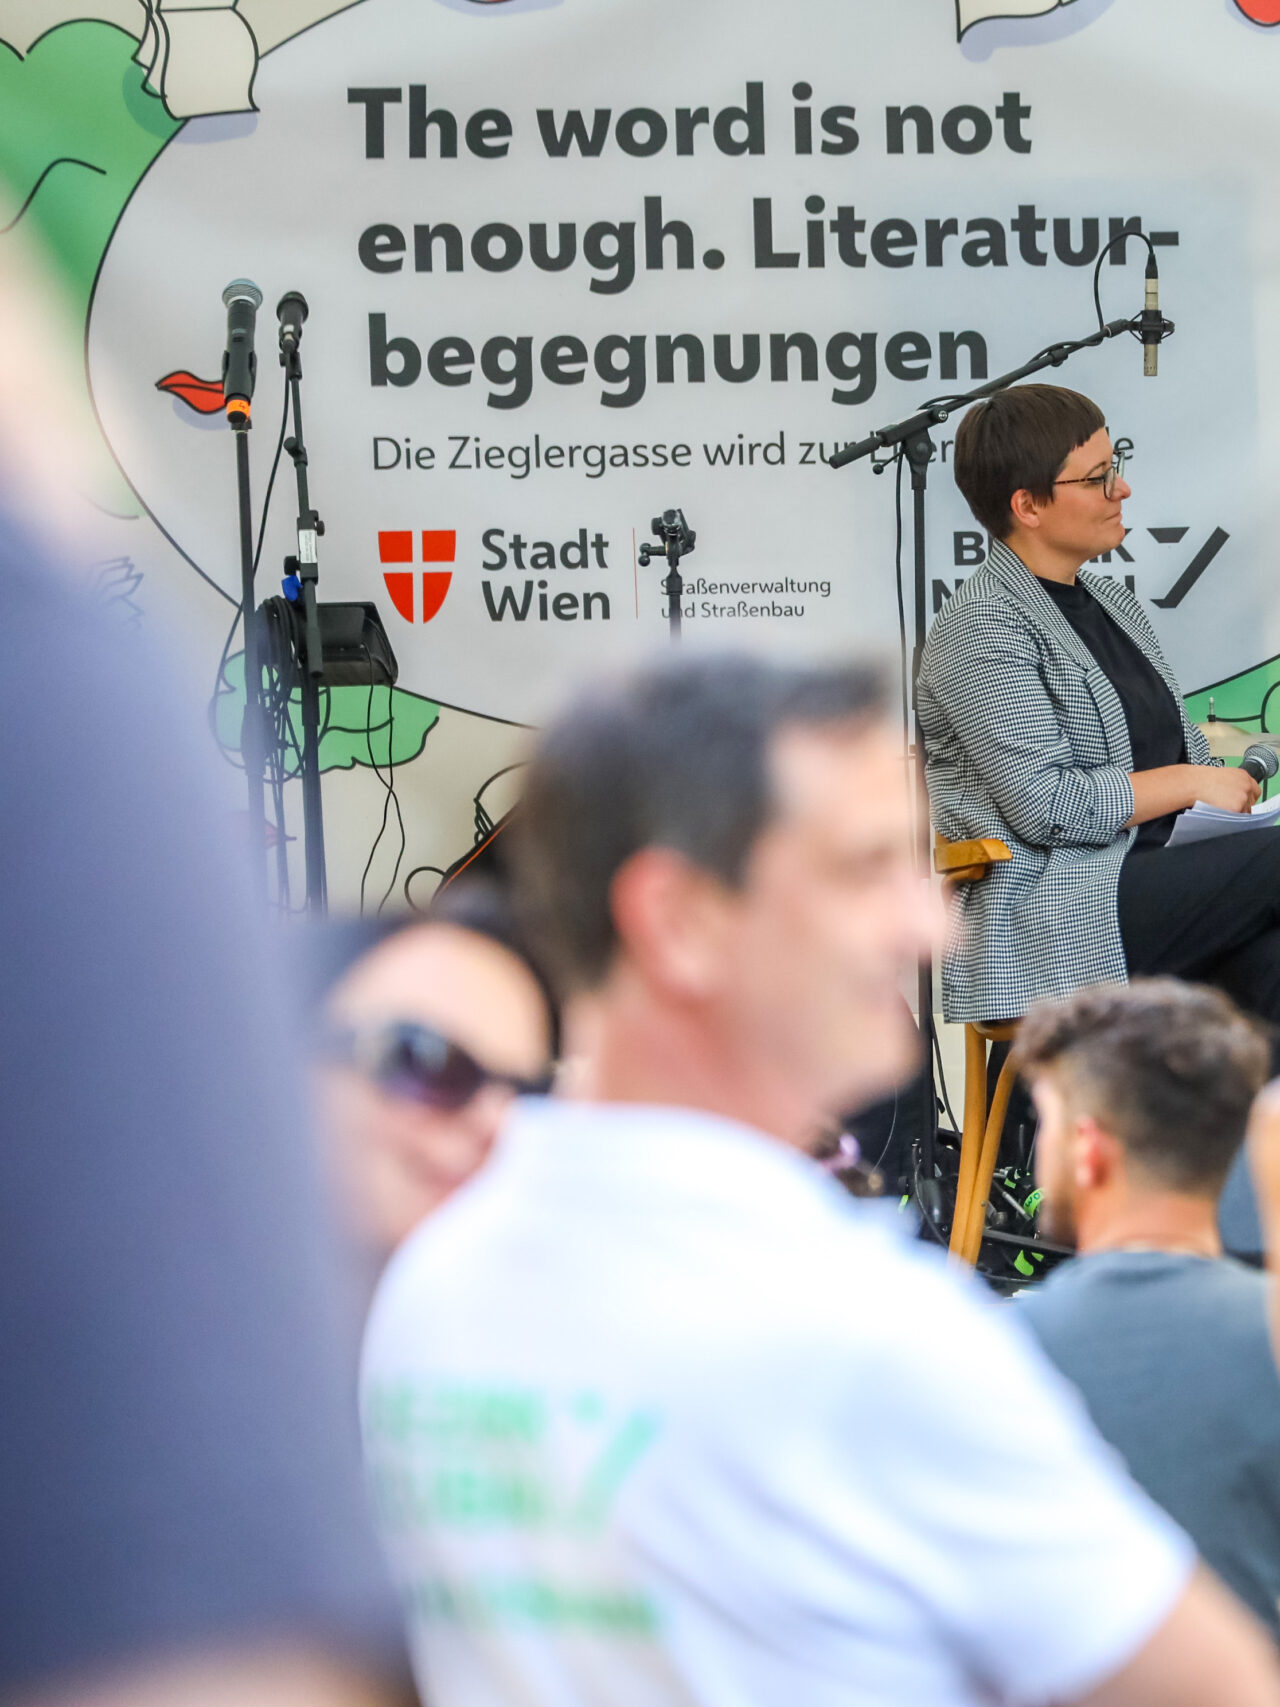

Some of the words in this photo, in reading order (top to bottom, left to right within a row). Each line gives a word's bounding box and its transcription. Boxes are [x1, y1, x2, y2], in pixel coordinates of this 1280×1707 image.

[347, 84, 513, 159] The
[535, 81, 766, 158] word
[792, 81, 860, 156] is
[885, 92, 1033, 156] not
[357, 196, 726, 295] enough.
[752, 194, 1180, 270] Literatur-
[368, 312, 989, 410] begegnungen
[372, 436, 436, 470] Die
[447, 433, 693, 480] Zieglergasse
[702, 431, 786, 467] wird
[481, 528, 610, 571] Stadt
[481, 579, 612, 622] Wien
[700, 600, 806, 618] Straßenbau
